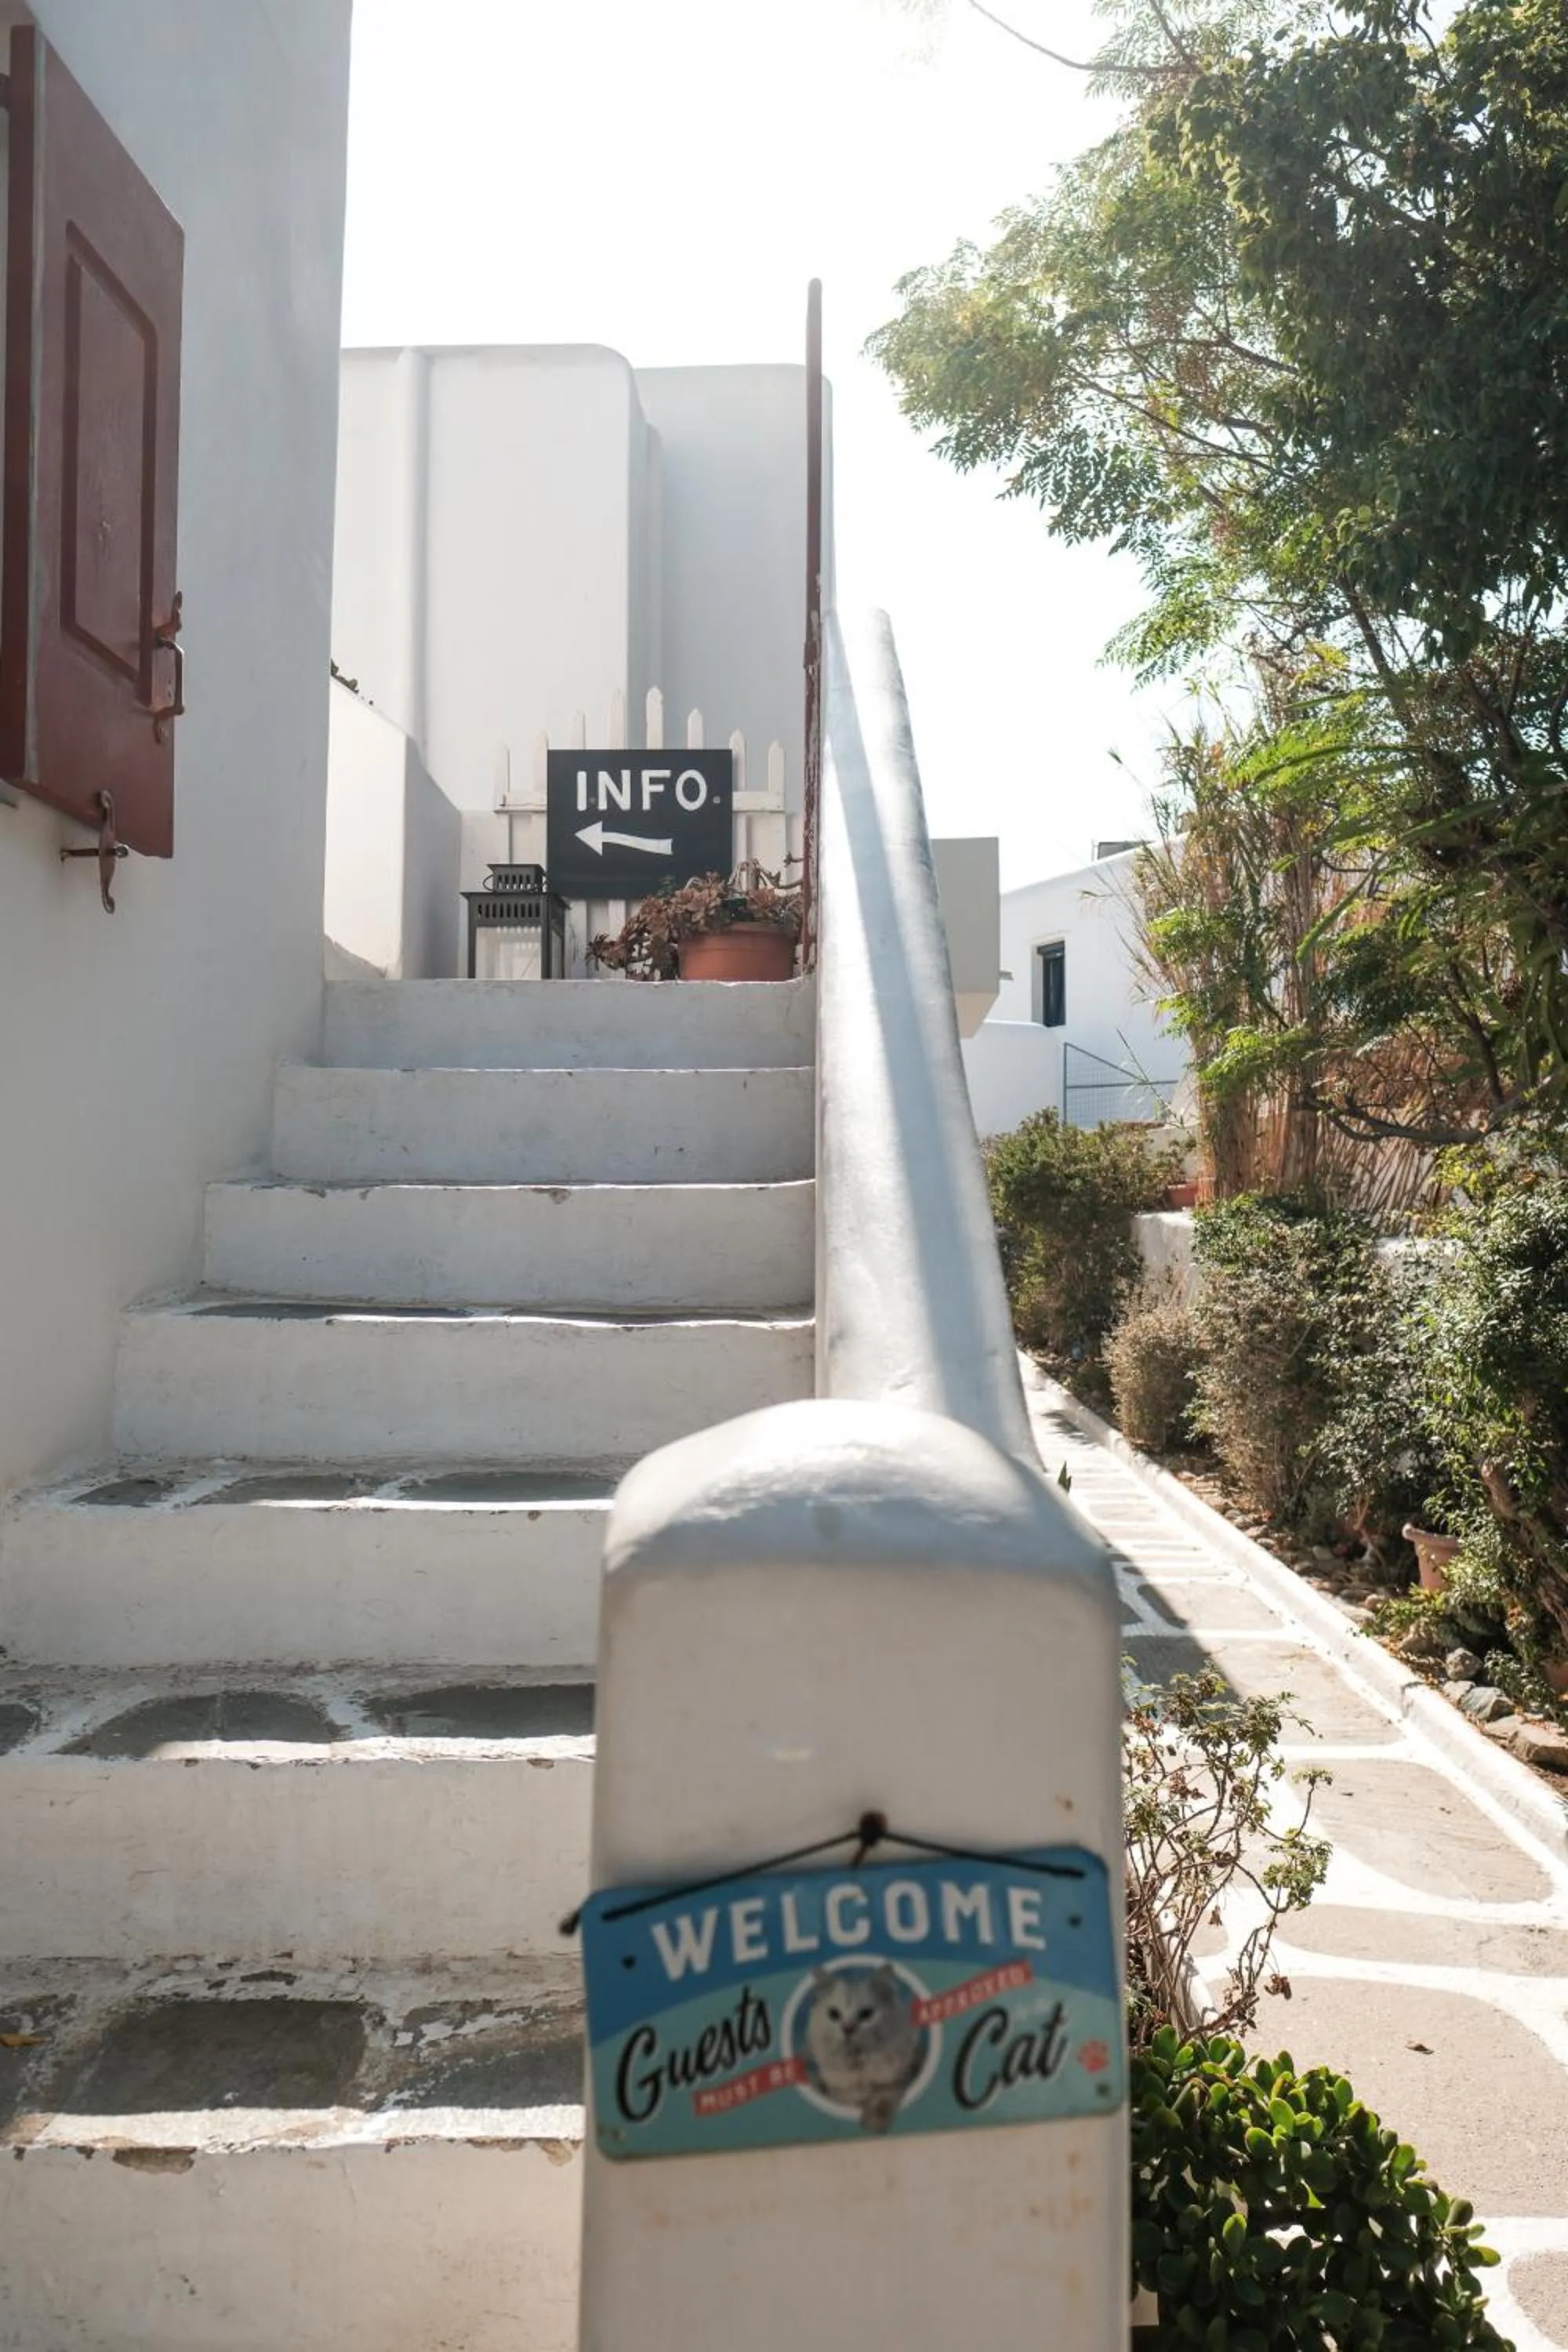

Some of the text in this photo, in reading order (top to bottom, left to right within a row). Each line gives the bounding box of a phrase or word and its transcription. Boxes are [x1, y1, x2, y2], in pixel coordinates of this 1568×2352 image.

[576, 769, 707, 811] INFO
[652, 1881, 1047, 1980] WELCOME
[919, 1968, 1026, 2024] APPROVED
[616, 1987, 771, 2123] Guests
[699, 2063, 796, 2111] MUST BE
[953, 2002, 1069, 2111] Cat
